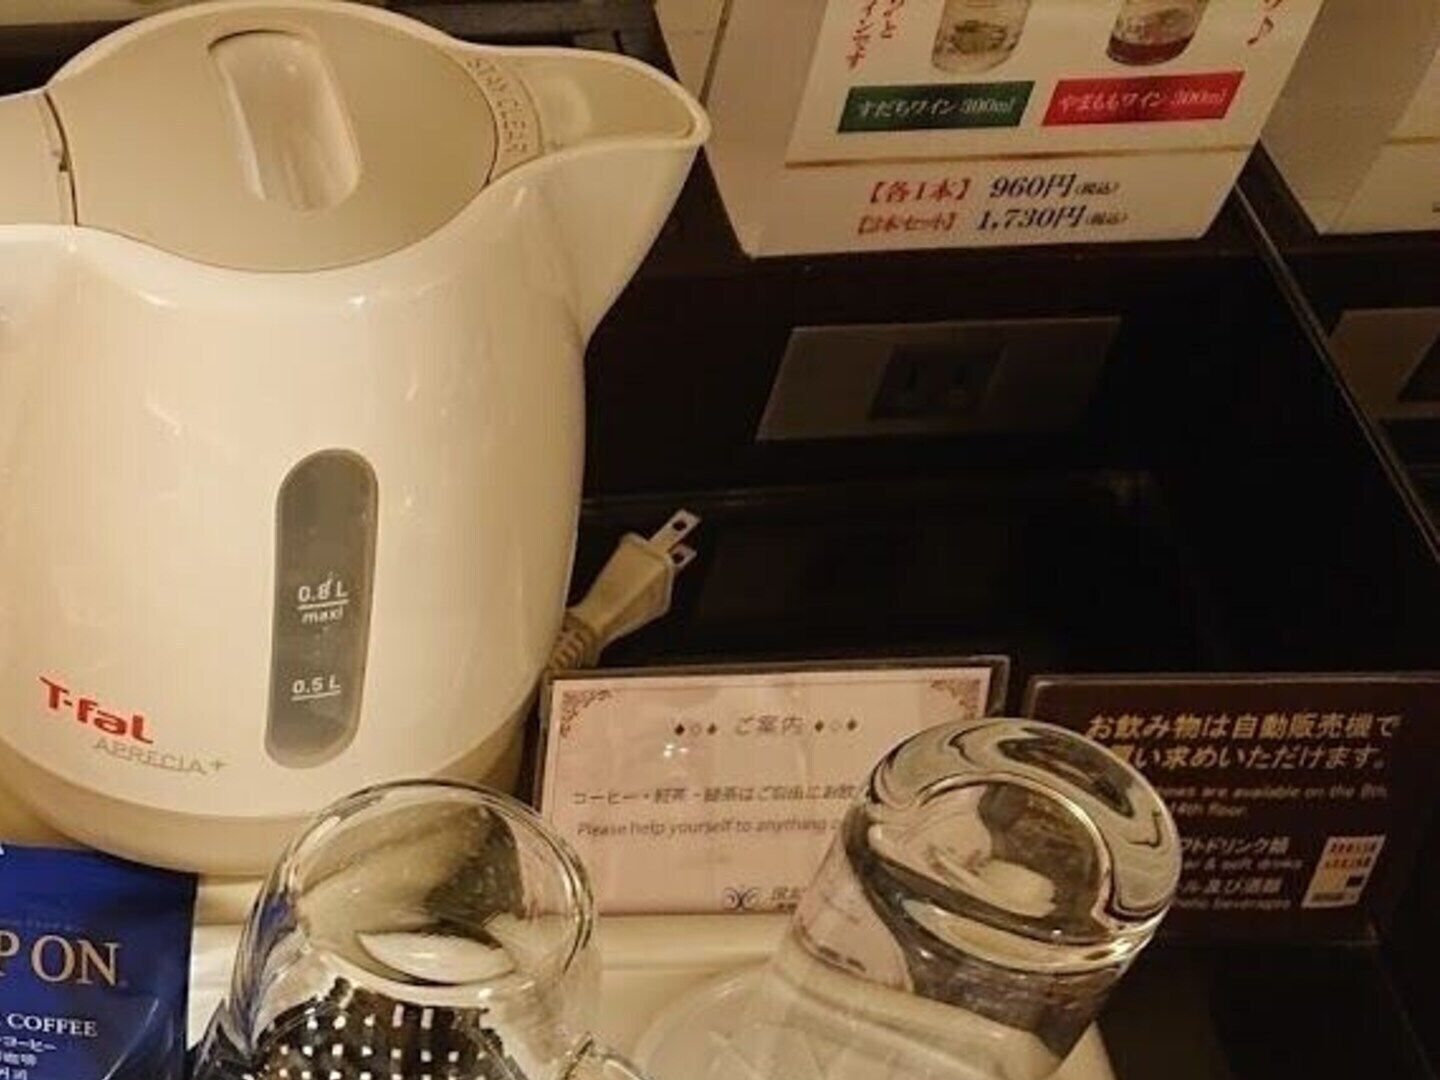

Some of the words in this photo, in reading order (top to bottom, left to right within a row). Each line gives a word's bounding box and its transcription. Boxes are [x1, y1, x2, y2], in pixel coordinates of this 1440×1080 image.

[734, 714, 804, 737] ご案内
[1086, 712, 1401, 741] お飲み物は自動販売機で
[1110, 744, 1385, 770] 買い求めいただけます。
[30, 934, 122, 988] ON
[6, 1012, 99, 1038] COFFEE
